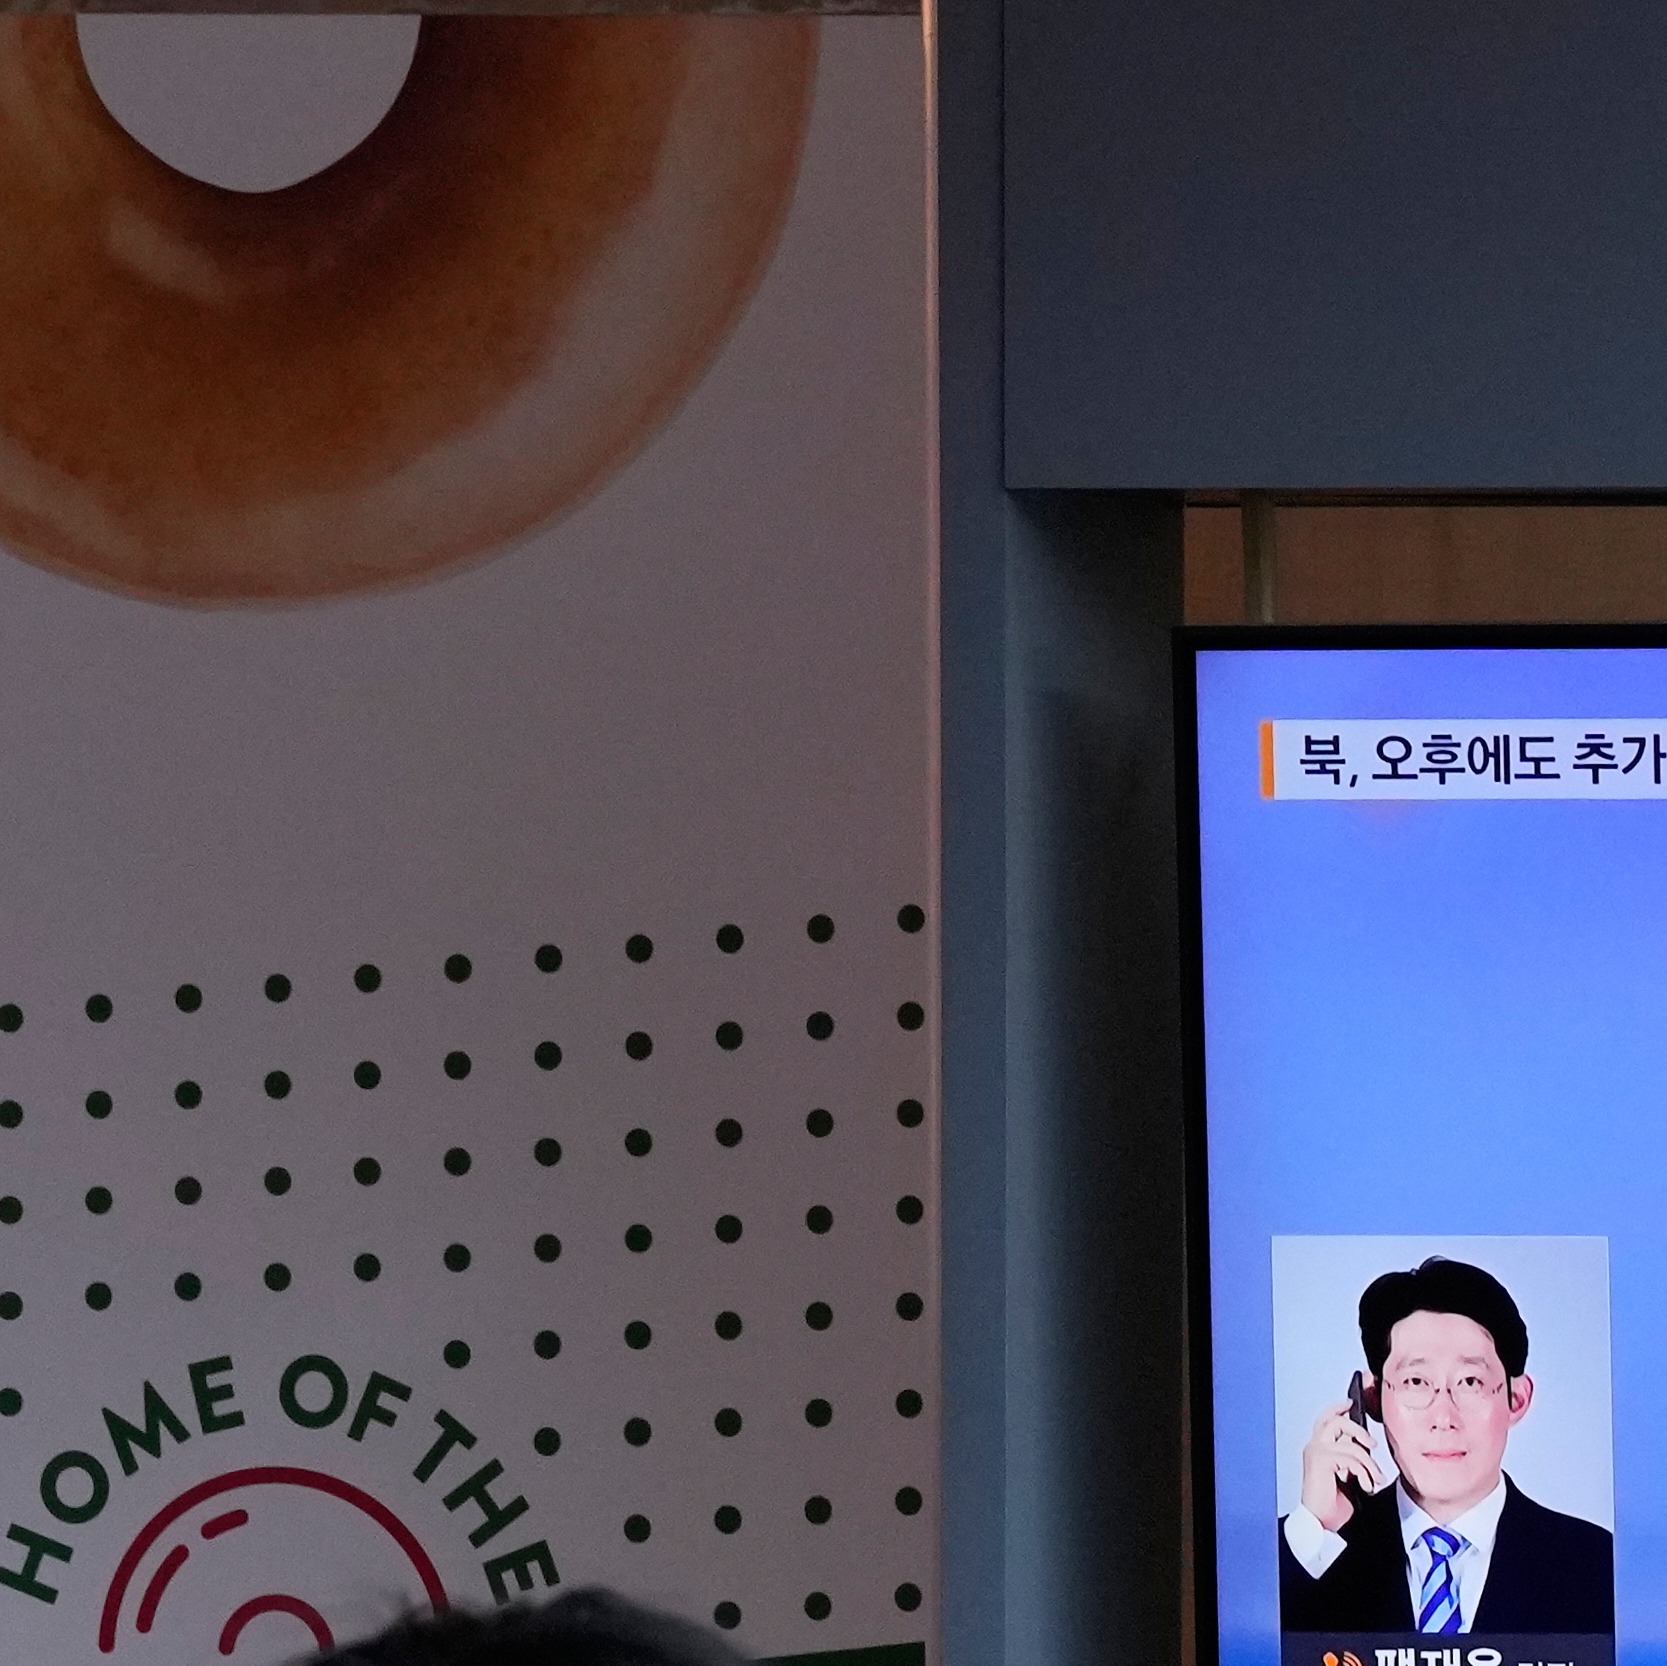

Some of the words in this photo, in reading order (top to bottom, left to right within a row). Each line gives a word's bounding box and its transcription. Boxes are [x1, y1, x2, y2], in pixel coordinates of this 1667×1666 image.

[1299, 734, 1358, 788] 북,
[1371, 733, 1561, 785] 오후에도
[1572, 732, 1667, 784] 추가
[0, 1354, 246, 1605] HOME
[278, 1353, 413, 1443] OF
[412, 1408, 561, 1606] THE
